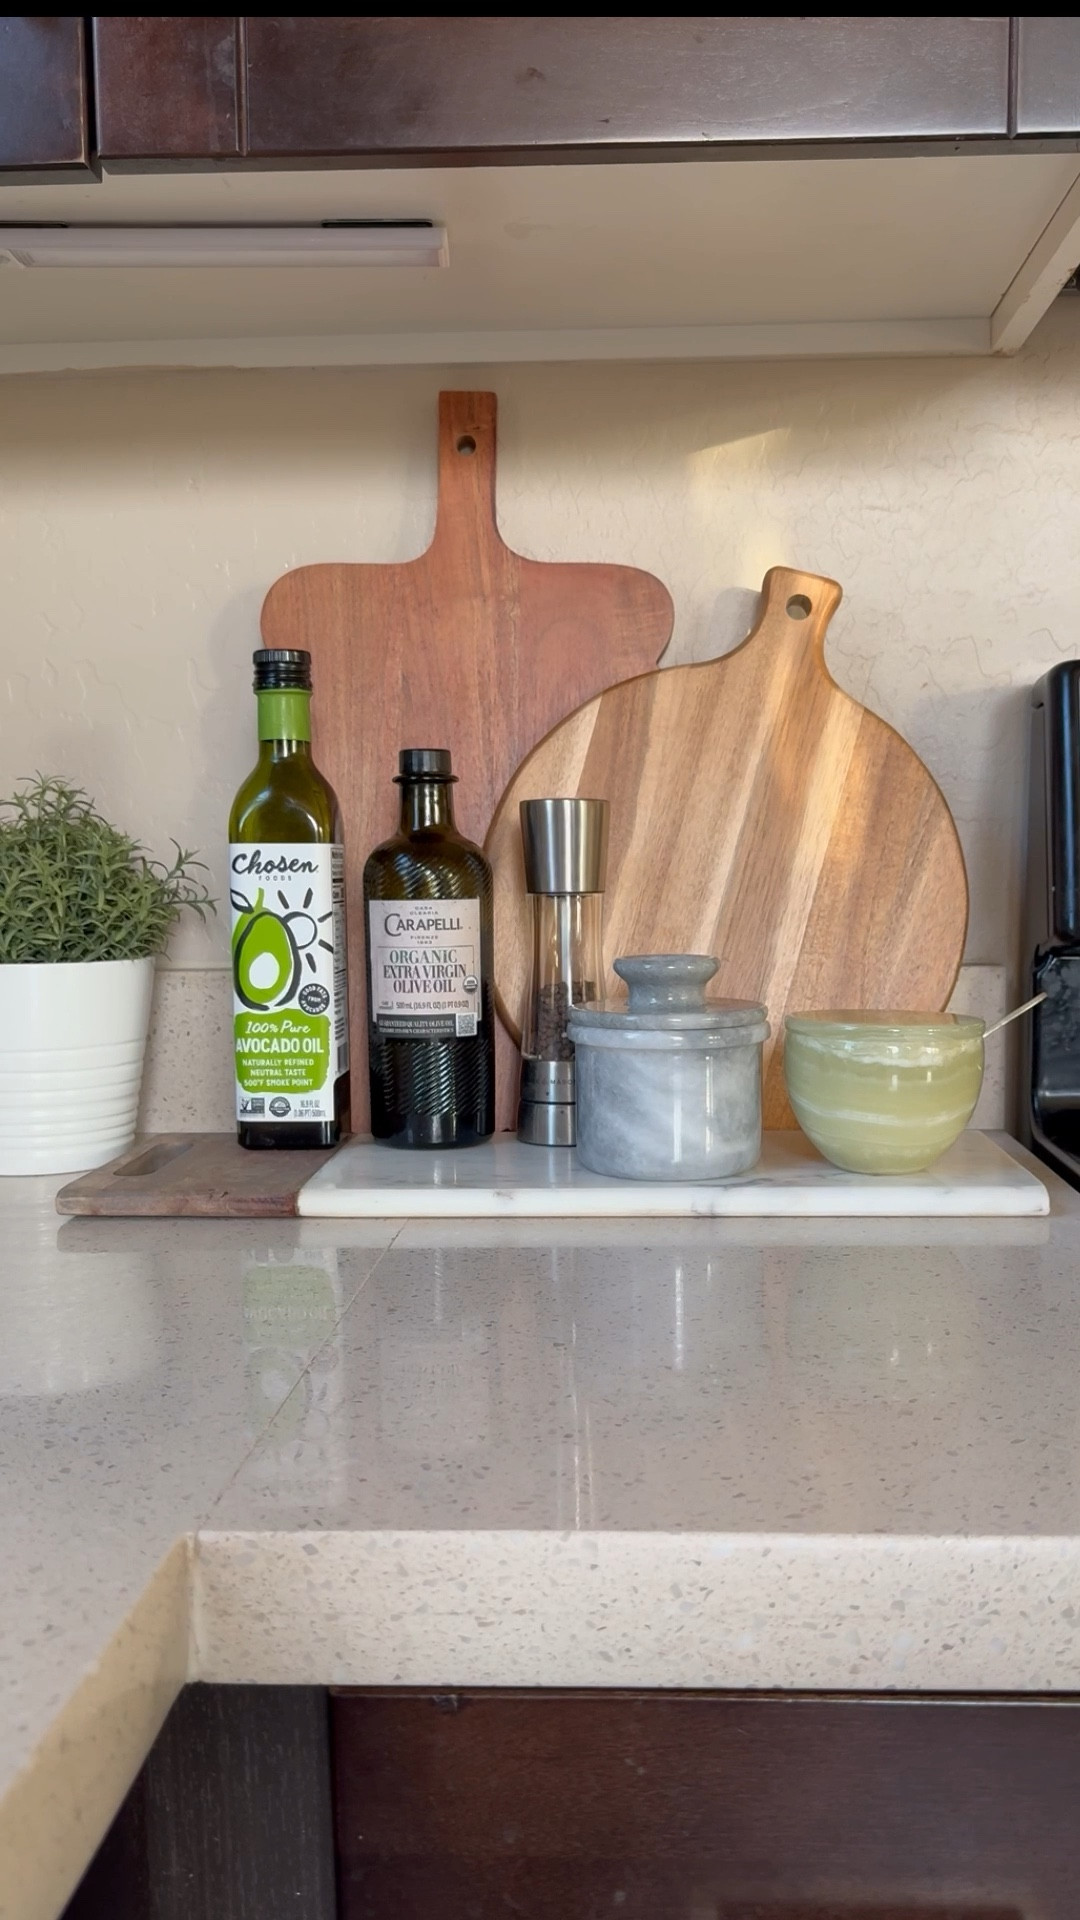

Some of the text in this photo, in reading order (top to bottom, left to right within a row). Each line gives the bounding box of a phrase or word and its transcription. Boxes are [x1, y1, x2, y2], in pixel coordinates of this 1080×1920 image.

[231, 849, 319, 875] Chosen
[384, 913, 460, 937] CARAPELLI
[389, 949, 458, 964] ORGANIC
[383, 964, 467, 979] EXTRA VIRGIN
[393, 980, 432, 994] OLIVE
[433, 979, 456, 993] OIL
[245, 1020, 311, 1034] 100% Pure
[236, 1038, 324, 1054] AVOCADO OIL
[242, 1058, 282, 1066] NATURALLY
[250, 1068, 282, 1076] NEUTRAL
[266, 1078, 290, 1086] SMOKE
[292, 1078, 313, 1086] POINT
